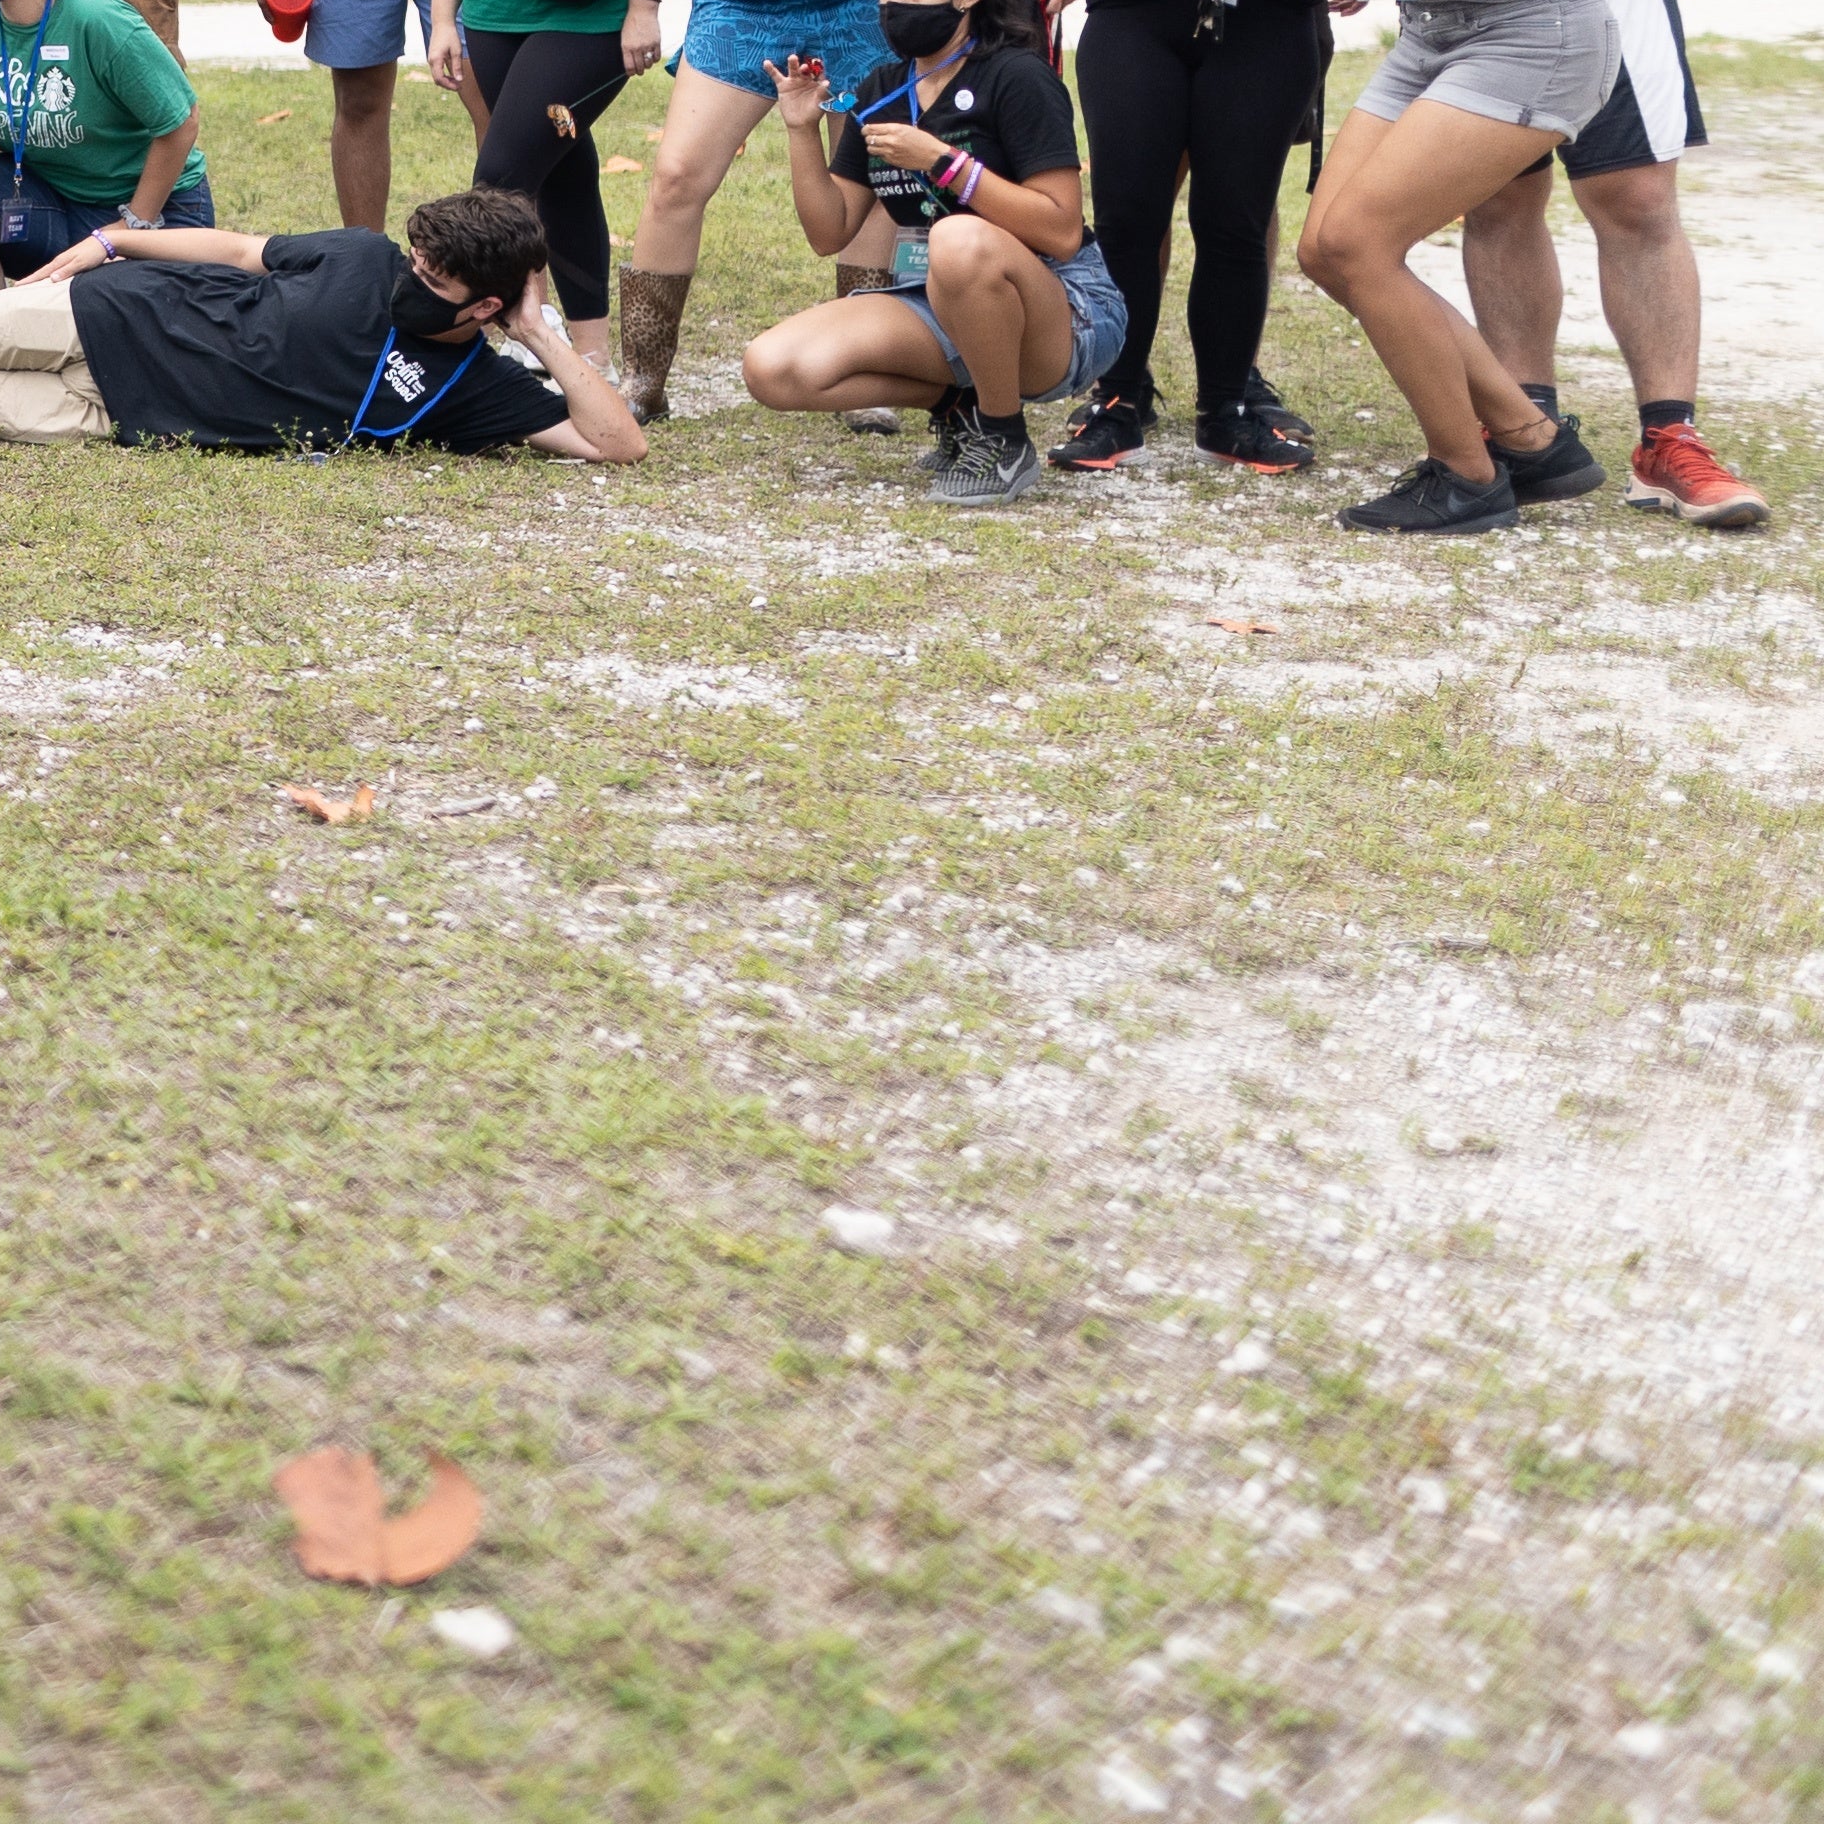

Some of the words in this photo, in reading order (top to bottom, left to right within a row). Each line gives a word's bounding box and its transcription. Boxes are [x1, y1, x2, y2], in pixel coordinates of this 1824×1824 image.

[7, 223, 24, 233] TEAM
[908, 256, 929, 265] TEA
[386, 350, 420, 386] Uplift
[384, 368, 419, 403] Squad
